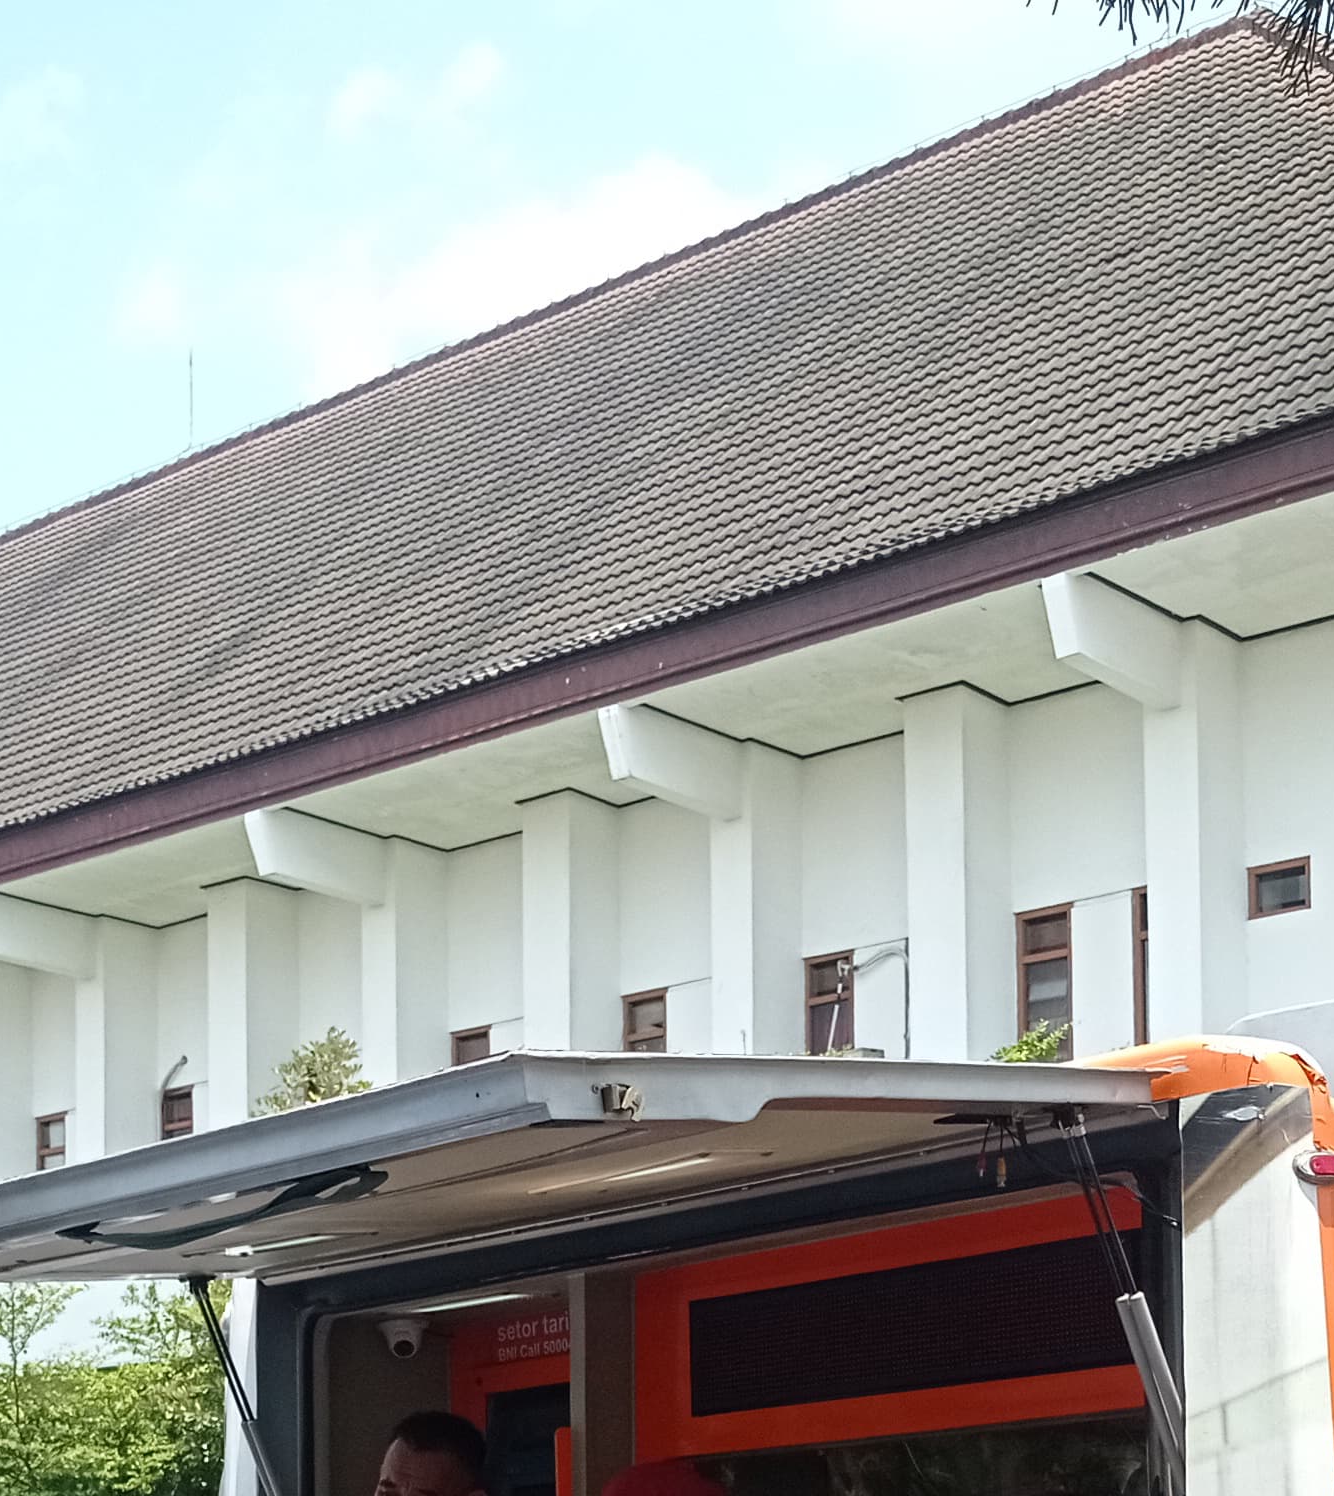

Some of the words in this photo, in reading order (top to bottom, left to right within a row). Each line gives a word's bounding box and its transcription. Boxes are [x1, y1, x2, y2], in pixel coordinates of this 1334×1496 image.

[498, 1321, 539, 1342] setor
[520, 1343, 540, 1358] Call
[543, 1338, 571, 1355] 5000
